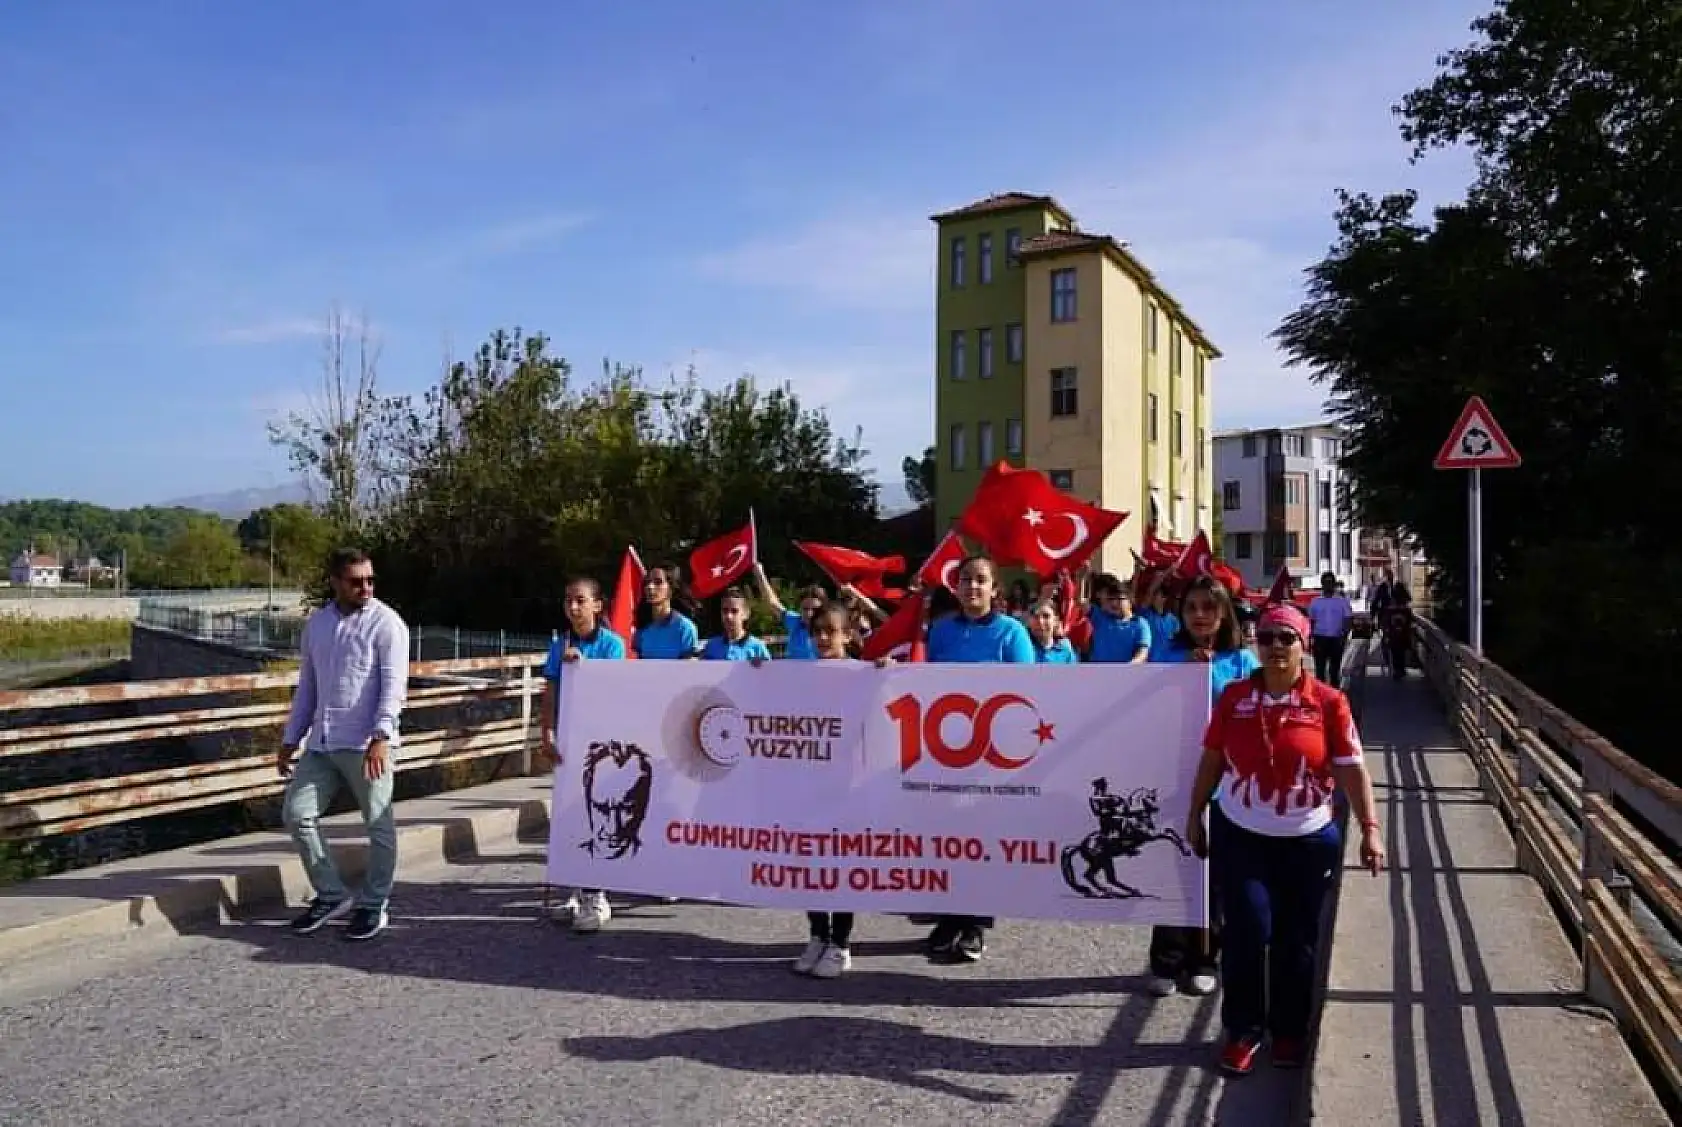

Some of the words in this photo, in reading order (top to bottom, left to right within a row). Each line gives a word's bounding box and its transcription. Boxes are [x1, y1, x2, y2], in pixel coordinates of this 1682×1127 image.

[885, 693, 1037, 771] 100
[666, 821, 923, 857] CUMHURİYETİMİZİN
[931, 836, 991, 862] 100.
[999, 839, 1056, 865] YILI
[751, 862, 840, 890] KUTLU
[848, 866, 949, 892] OLSUN
